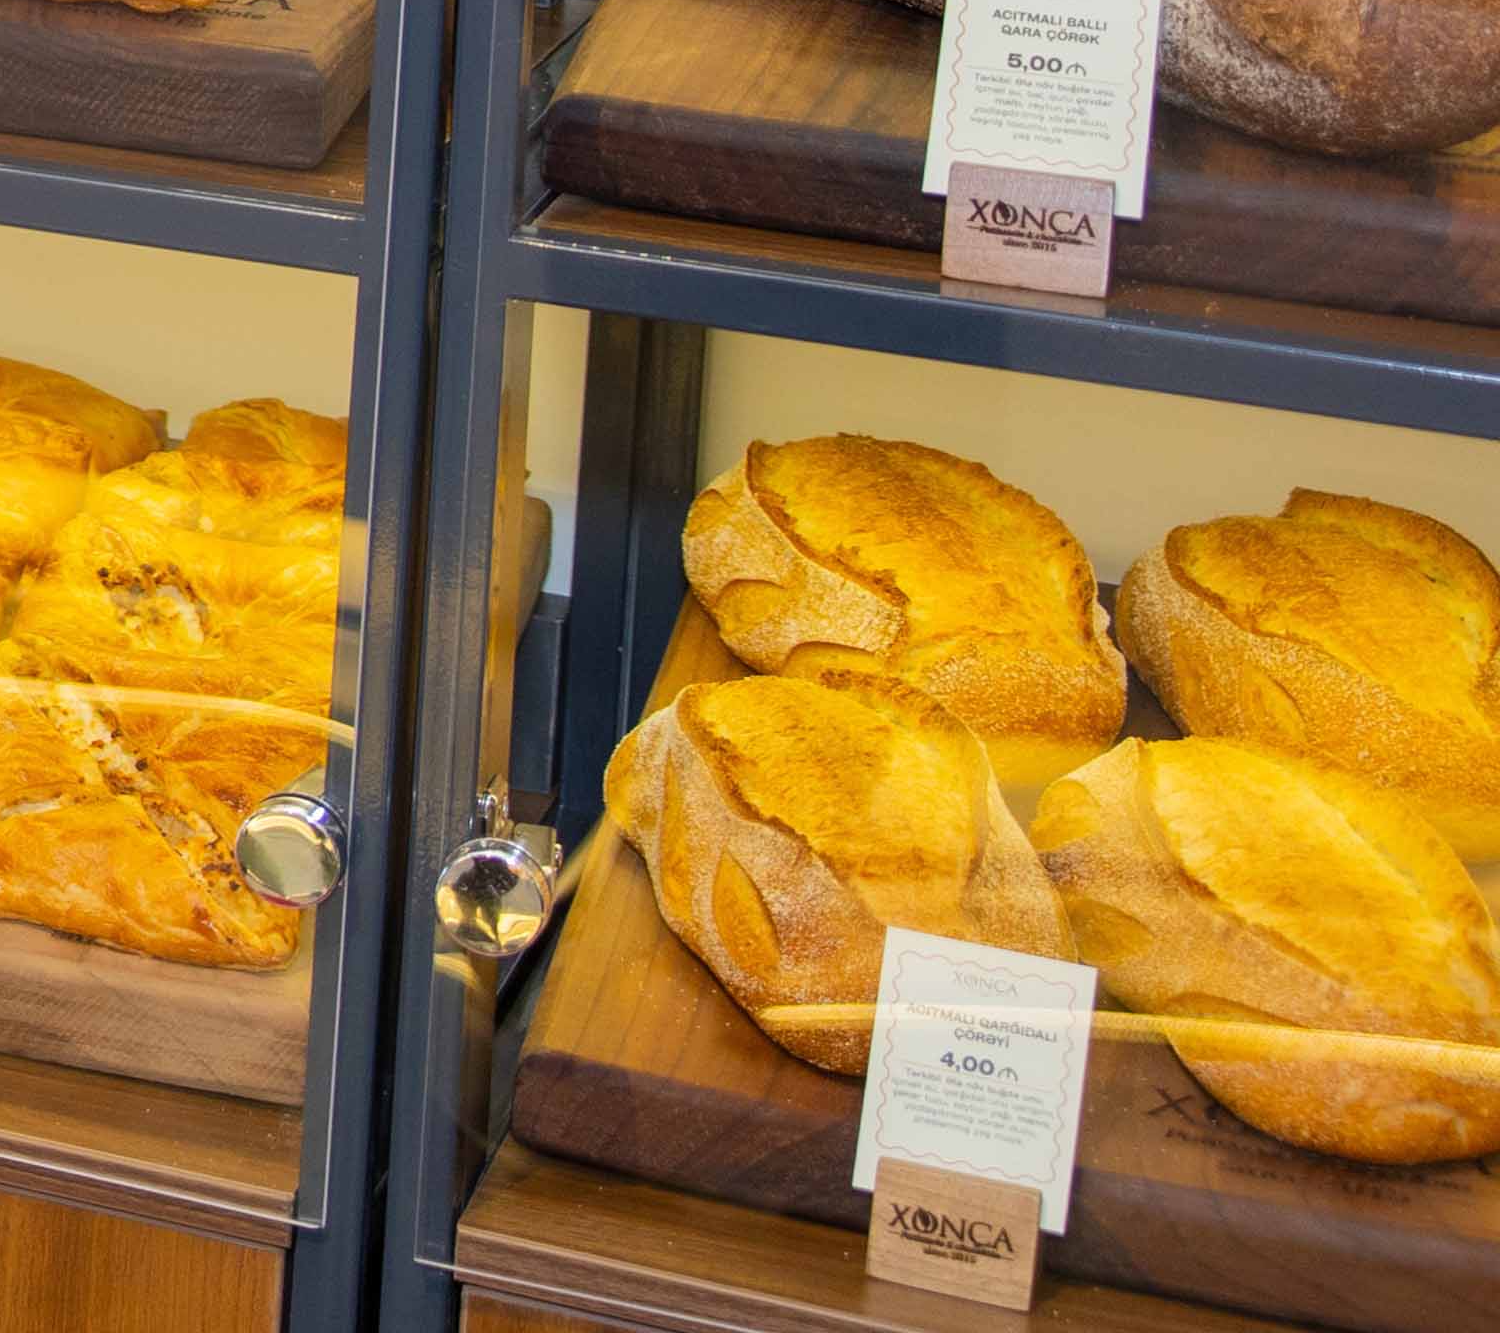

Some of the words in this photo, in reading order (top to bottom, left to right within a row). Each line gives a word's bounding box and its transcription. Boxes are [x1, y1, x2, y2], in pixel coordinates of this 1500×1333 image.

[992, 9, 1062, 26] ACITMALI
[1067, 17, 1107, 31] BALLI
[1001, 24, 1041, 38] QARA
[1046, 29, 1100, 45] ÇÖRƏK
[1007, 53, 1063, 73] 5,00
[907, 1002, 975, 1026] ACITMALI
[980, 1017, 1058, 1043] QARĞIDALI
[954, 1028, 1011, 1049] ÇÖRƏYİ
[940, 1051, 995, 1077] 4,00
